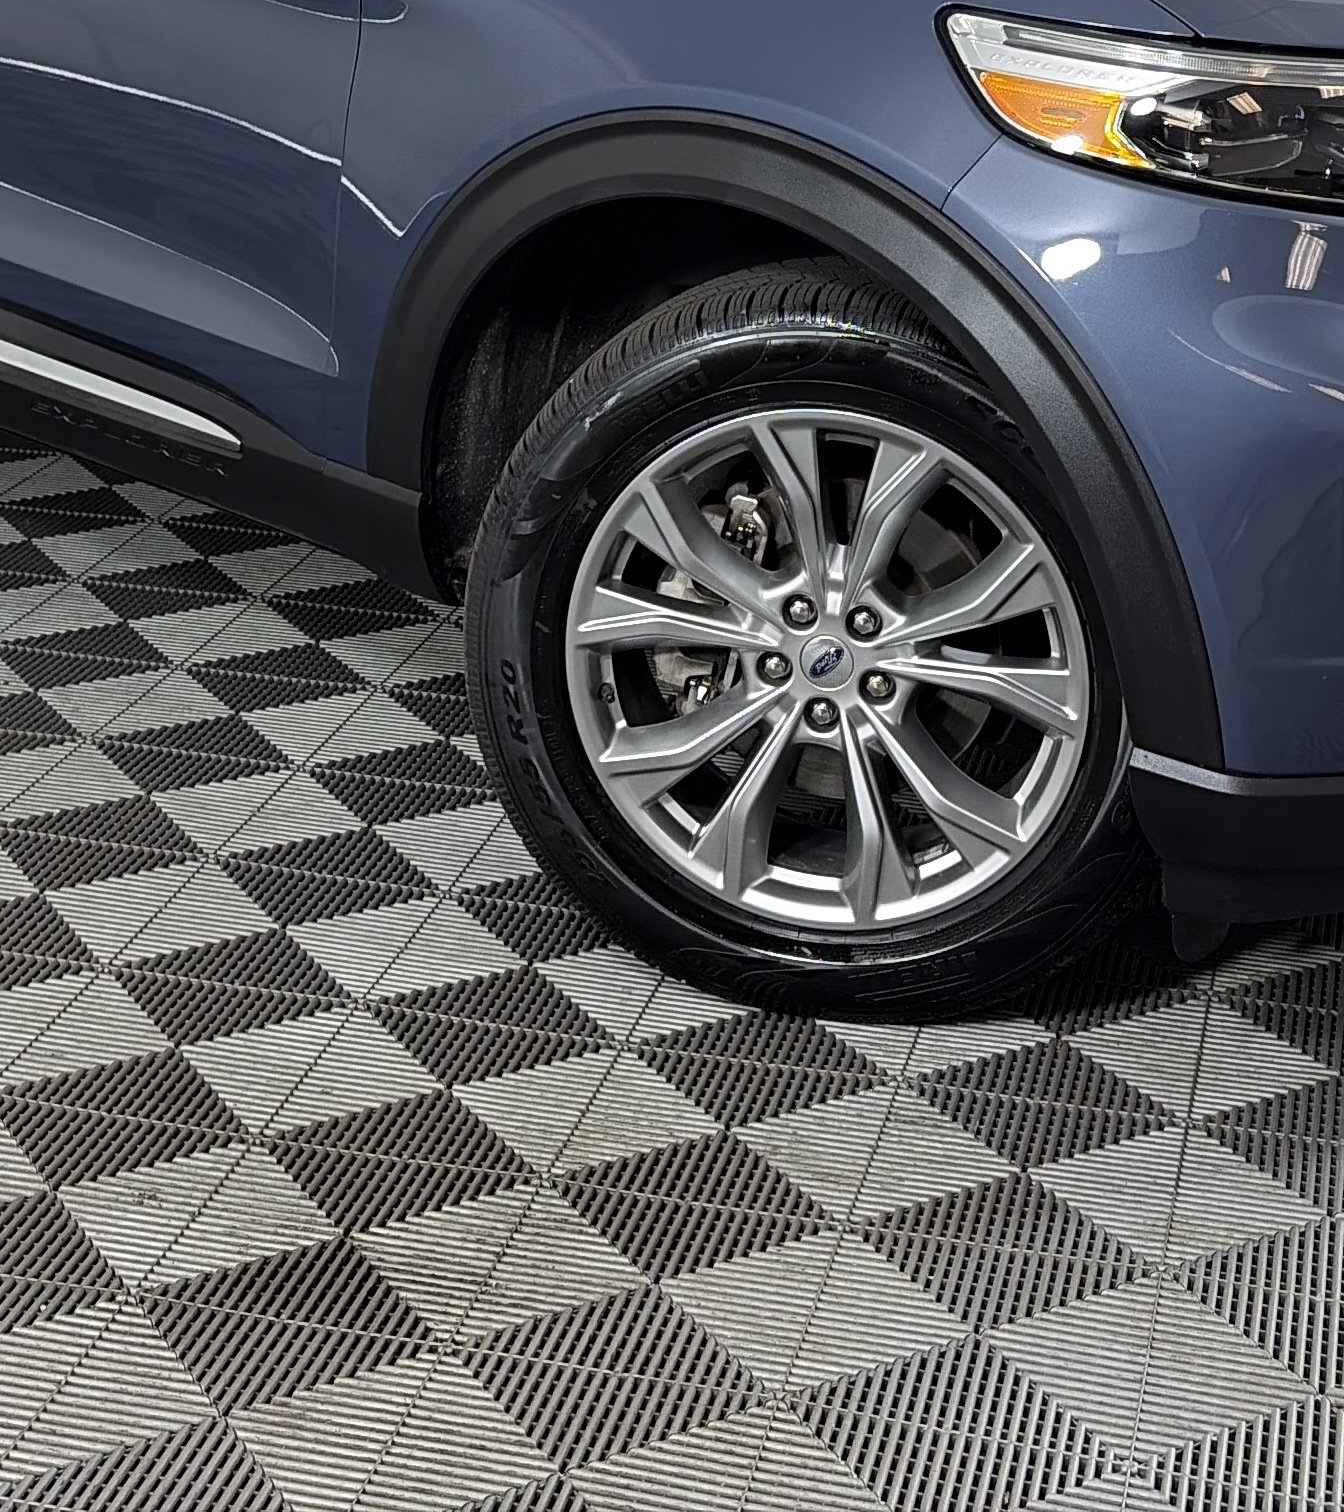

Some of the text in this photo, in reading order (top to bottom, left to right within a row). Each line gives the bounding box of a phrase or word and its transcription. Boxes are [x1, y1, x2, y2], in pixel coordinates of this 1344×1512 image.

[990, 52, 1136, 84] EXPLORER
[31, 401, 230, 477] EXPLORER
[500, 658, 528, 745] R20
